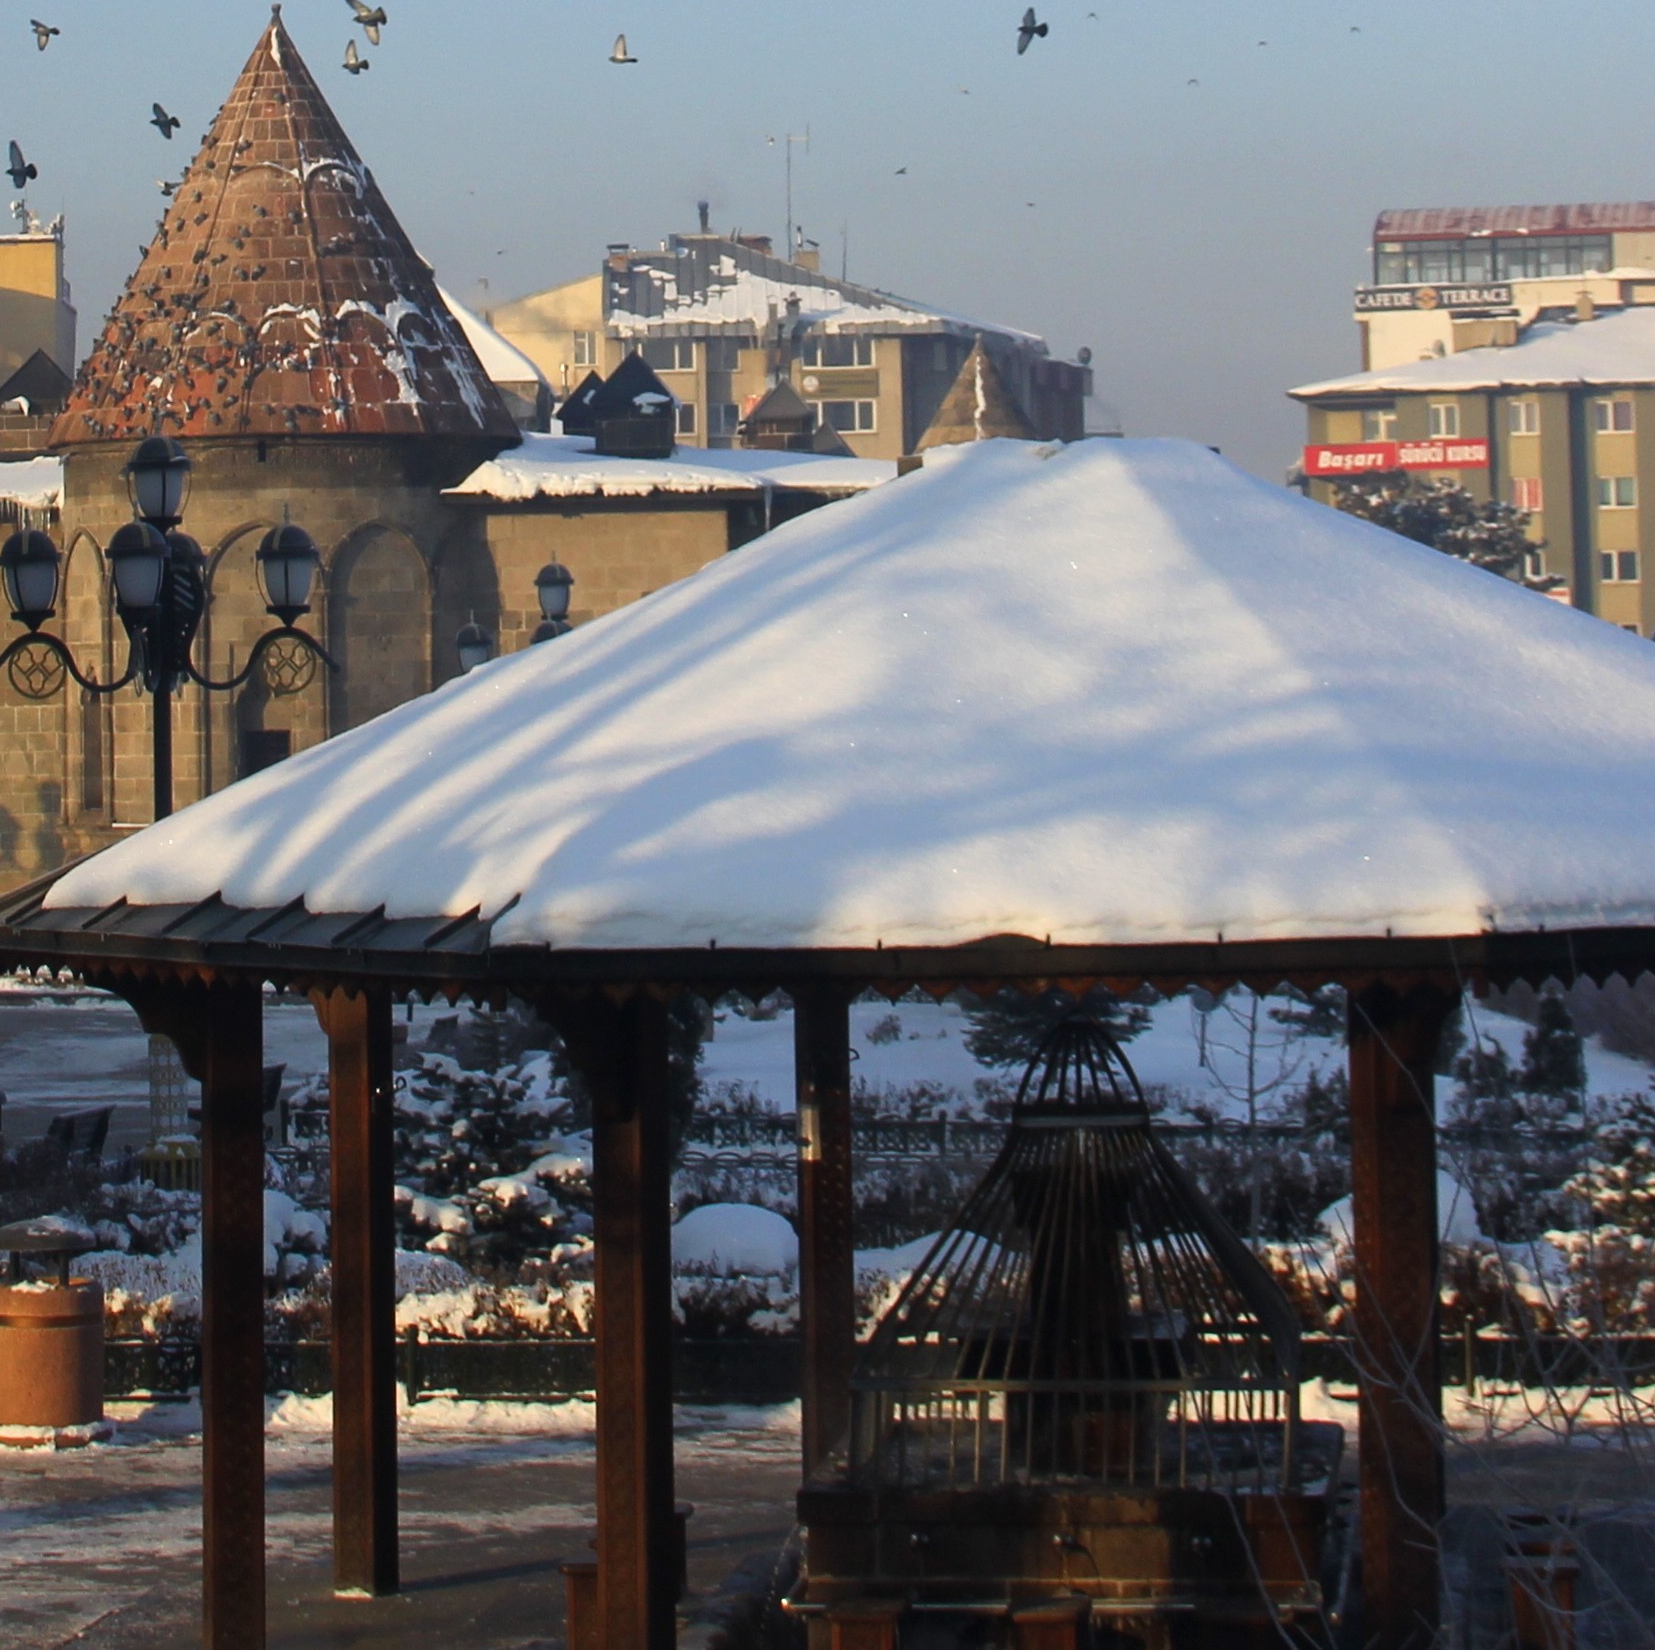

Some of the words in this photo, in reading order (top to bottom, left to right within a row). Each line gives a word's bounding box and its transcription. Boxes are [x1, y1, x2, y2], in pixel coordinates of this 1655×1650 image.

[1441, 288, 1508, 304] TERRACE
[1317, 450, 1384, 470] Başarı
[1399, 442, 1444, 464] SÜRÜCÜ
